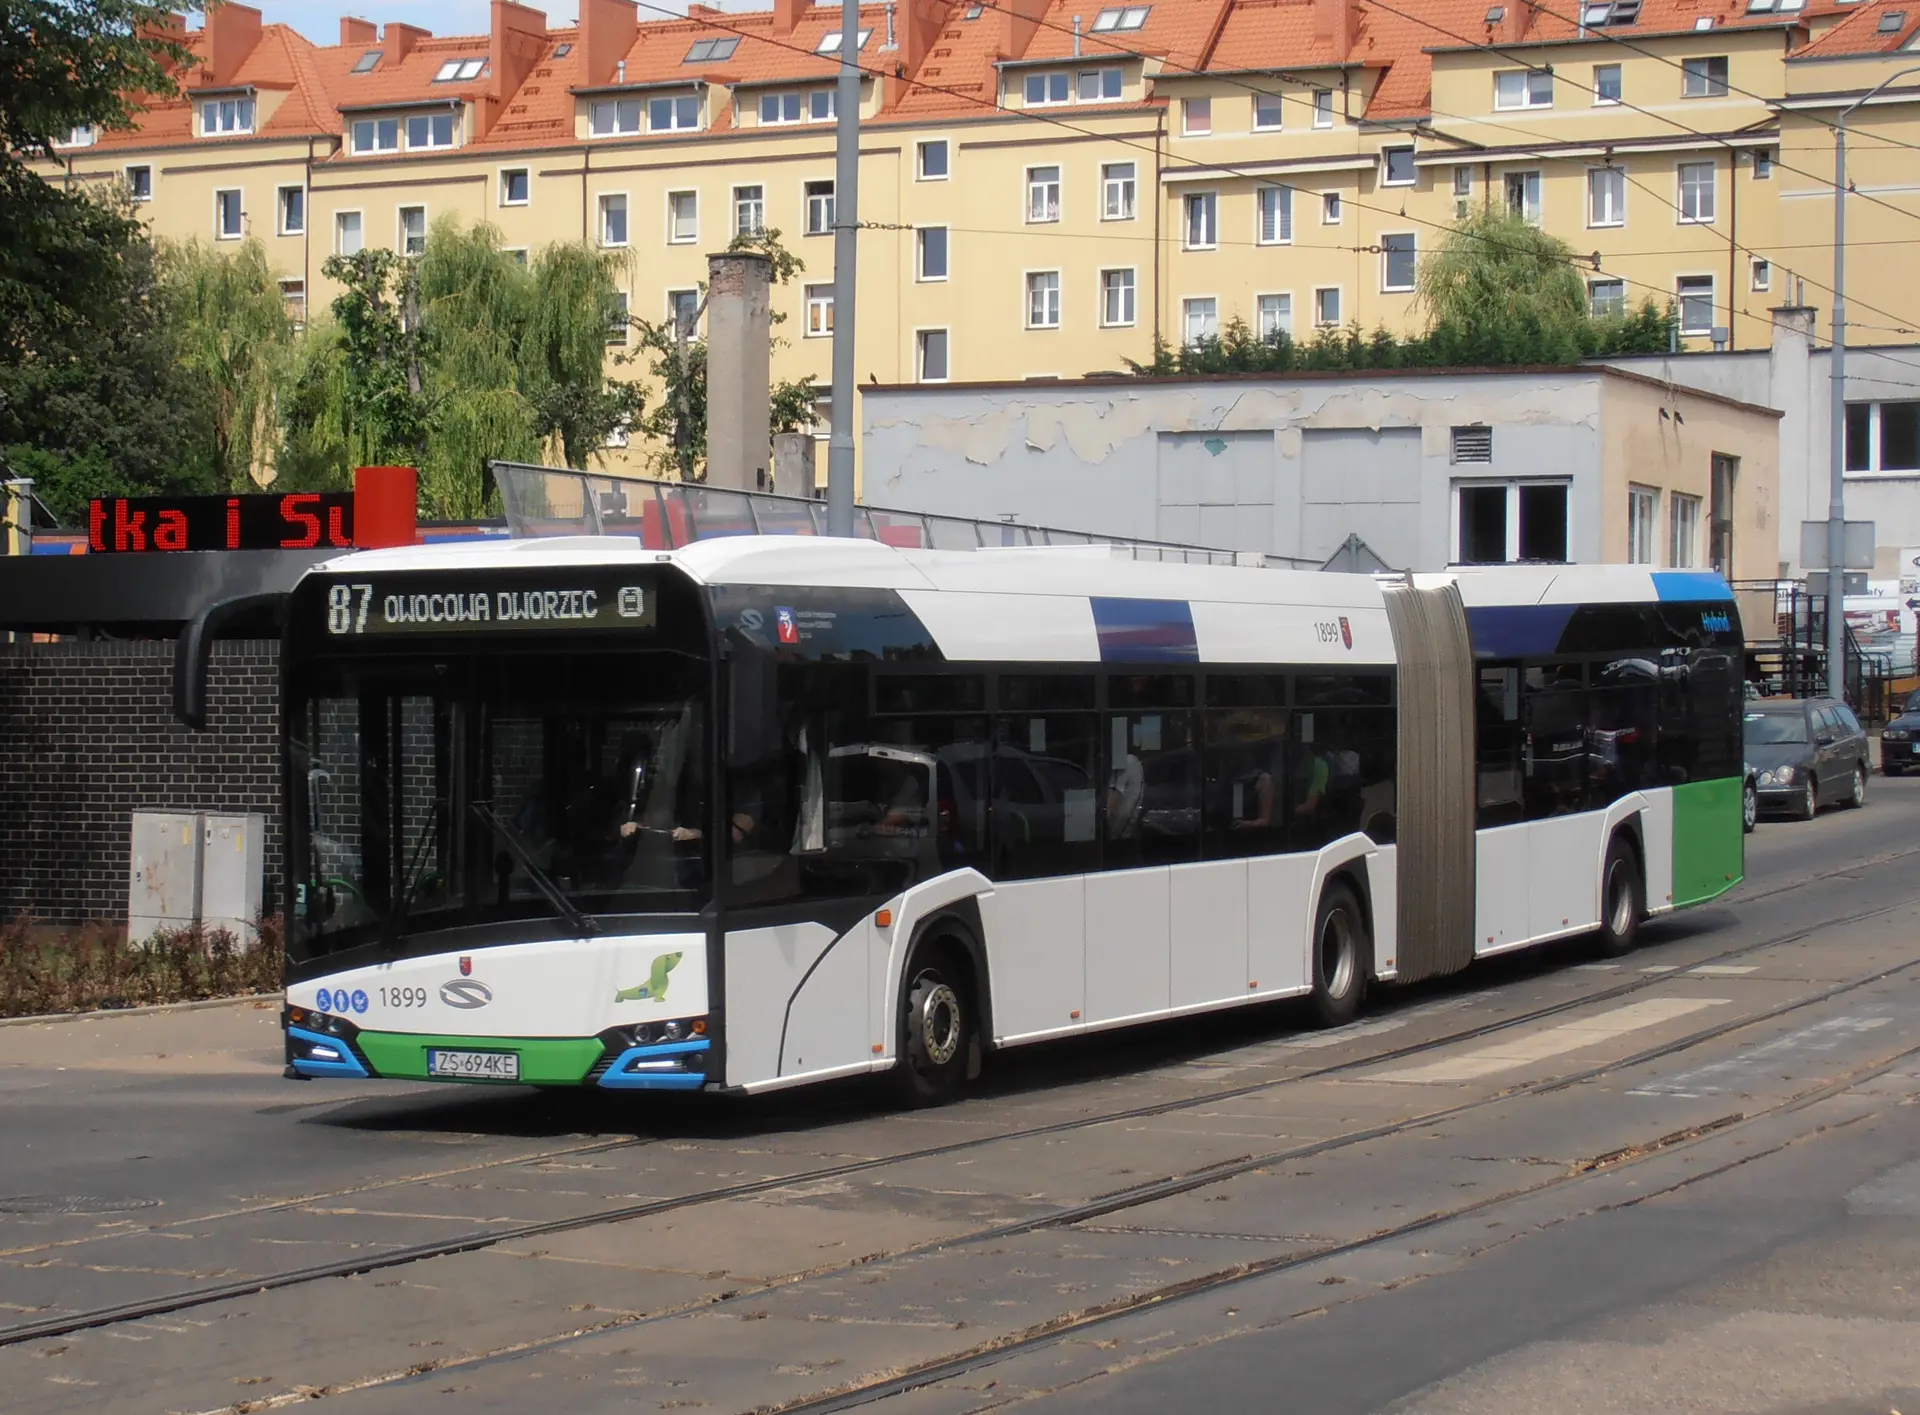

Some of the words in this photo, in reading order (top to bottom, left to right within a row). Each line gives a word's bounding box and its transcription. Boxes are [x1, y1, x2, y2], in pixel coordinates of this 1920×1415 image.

[227, 498, 239, 549] i
[328, 584, 373, 634] 87
[384, 593, 491, 623] OWOCOWA
[496, 590, 598, 620] DWORZEC
[1314, 622, 1338, 642] 1899
[379, 987, 427, 1008] 1899
[438, 1053, 459, 1071] ZS
[464, 1055, 514, 1073] 694KE
